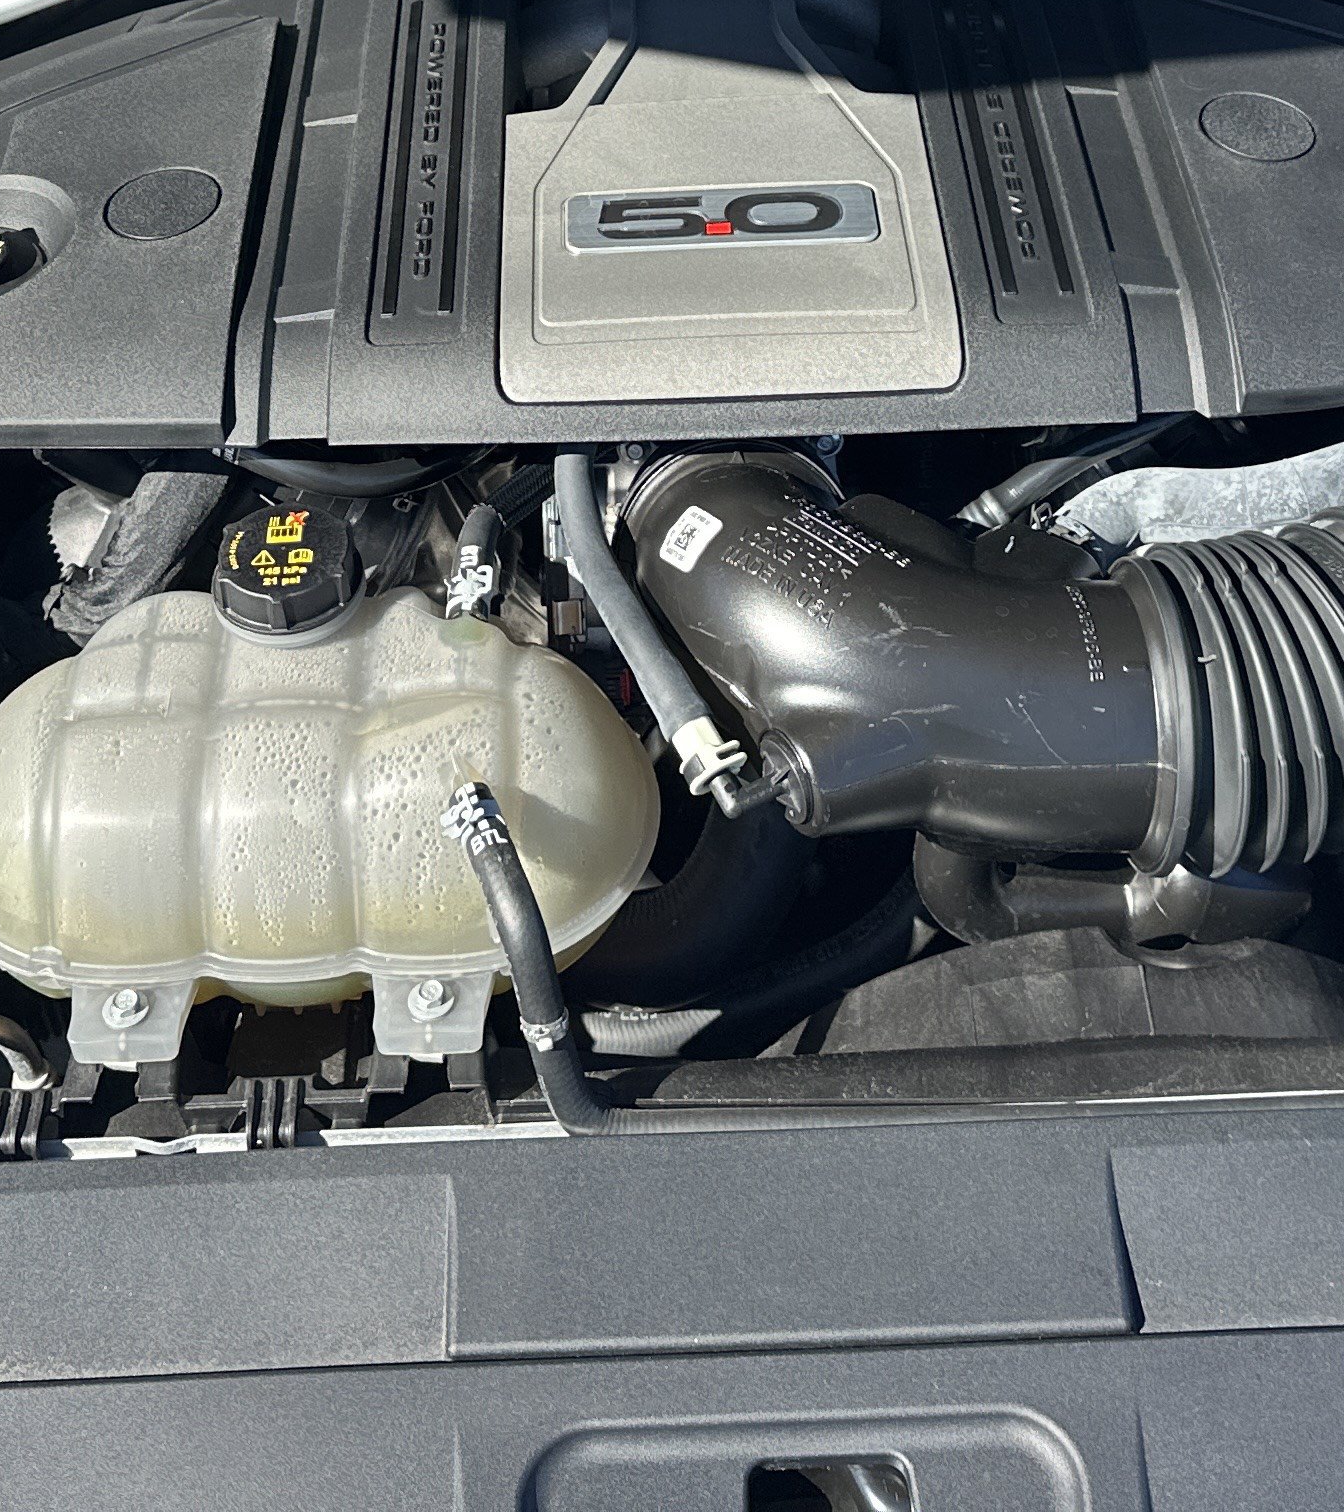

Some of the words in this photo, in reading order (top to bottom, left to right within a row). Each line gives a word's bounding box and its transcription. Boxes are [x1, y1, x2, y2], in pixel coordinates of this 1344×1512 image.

[422, 22, 447, 144] POWERED
[420, 153, 438, 189] BY
[993, 120, 1037, 261] POWERED
[412, 200, 435, 281] FORD
[596, 190, 843, 240] 5.0
[262, 576, 278, 586] 21
[281, 575, 301, 587] psi
[720, 544, 777, 584] MADE
[773, 571, 799, 598] IN
[796, 587, 836, 630] USA
[470, 828, 509, 856] BTL
